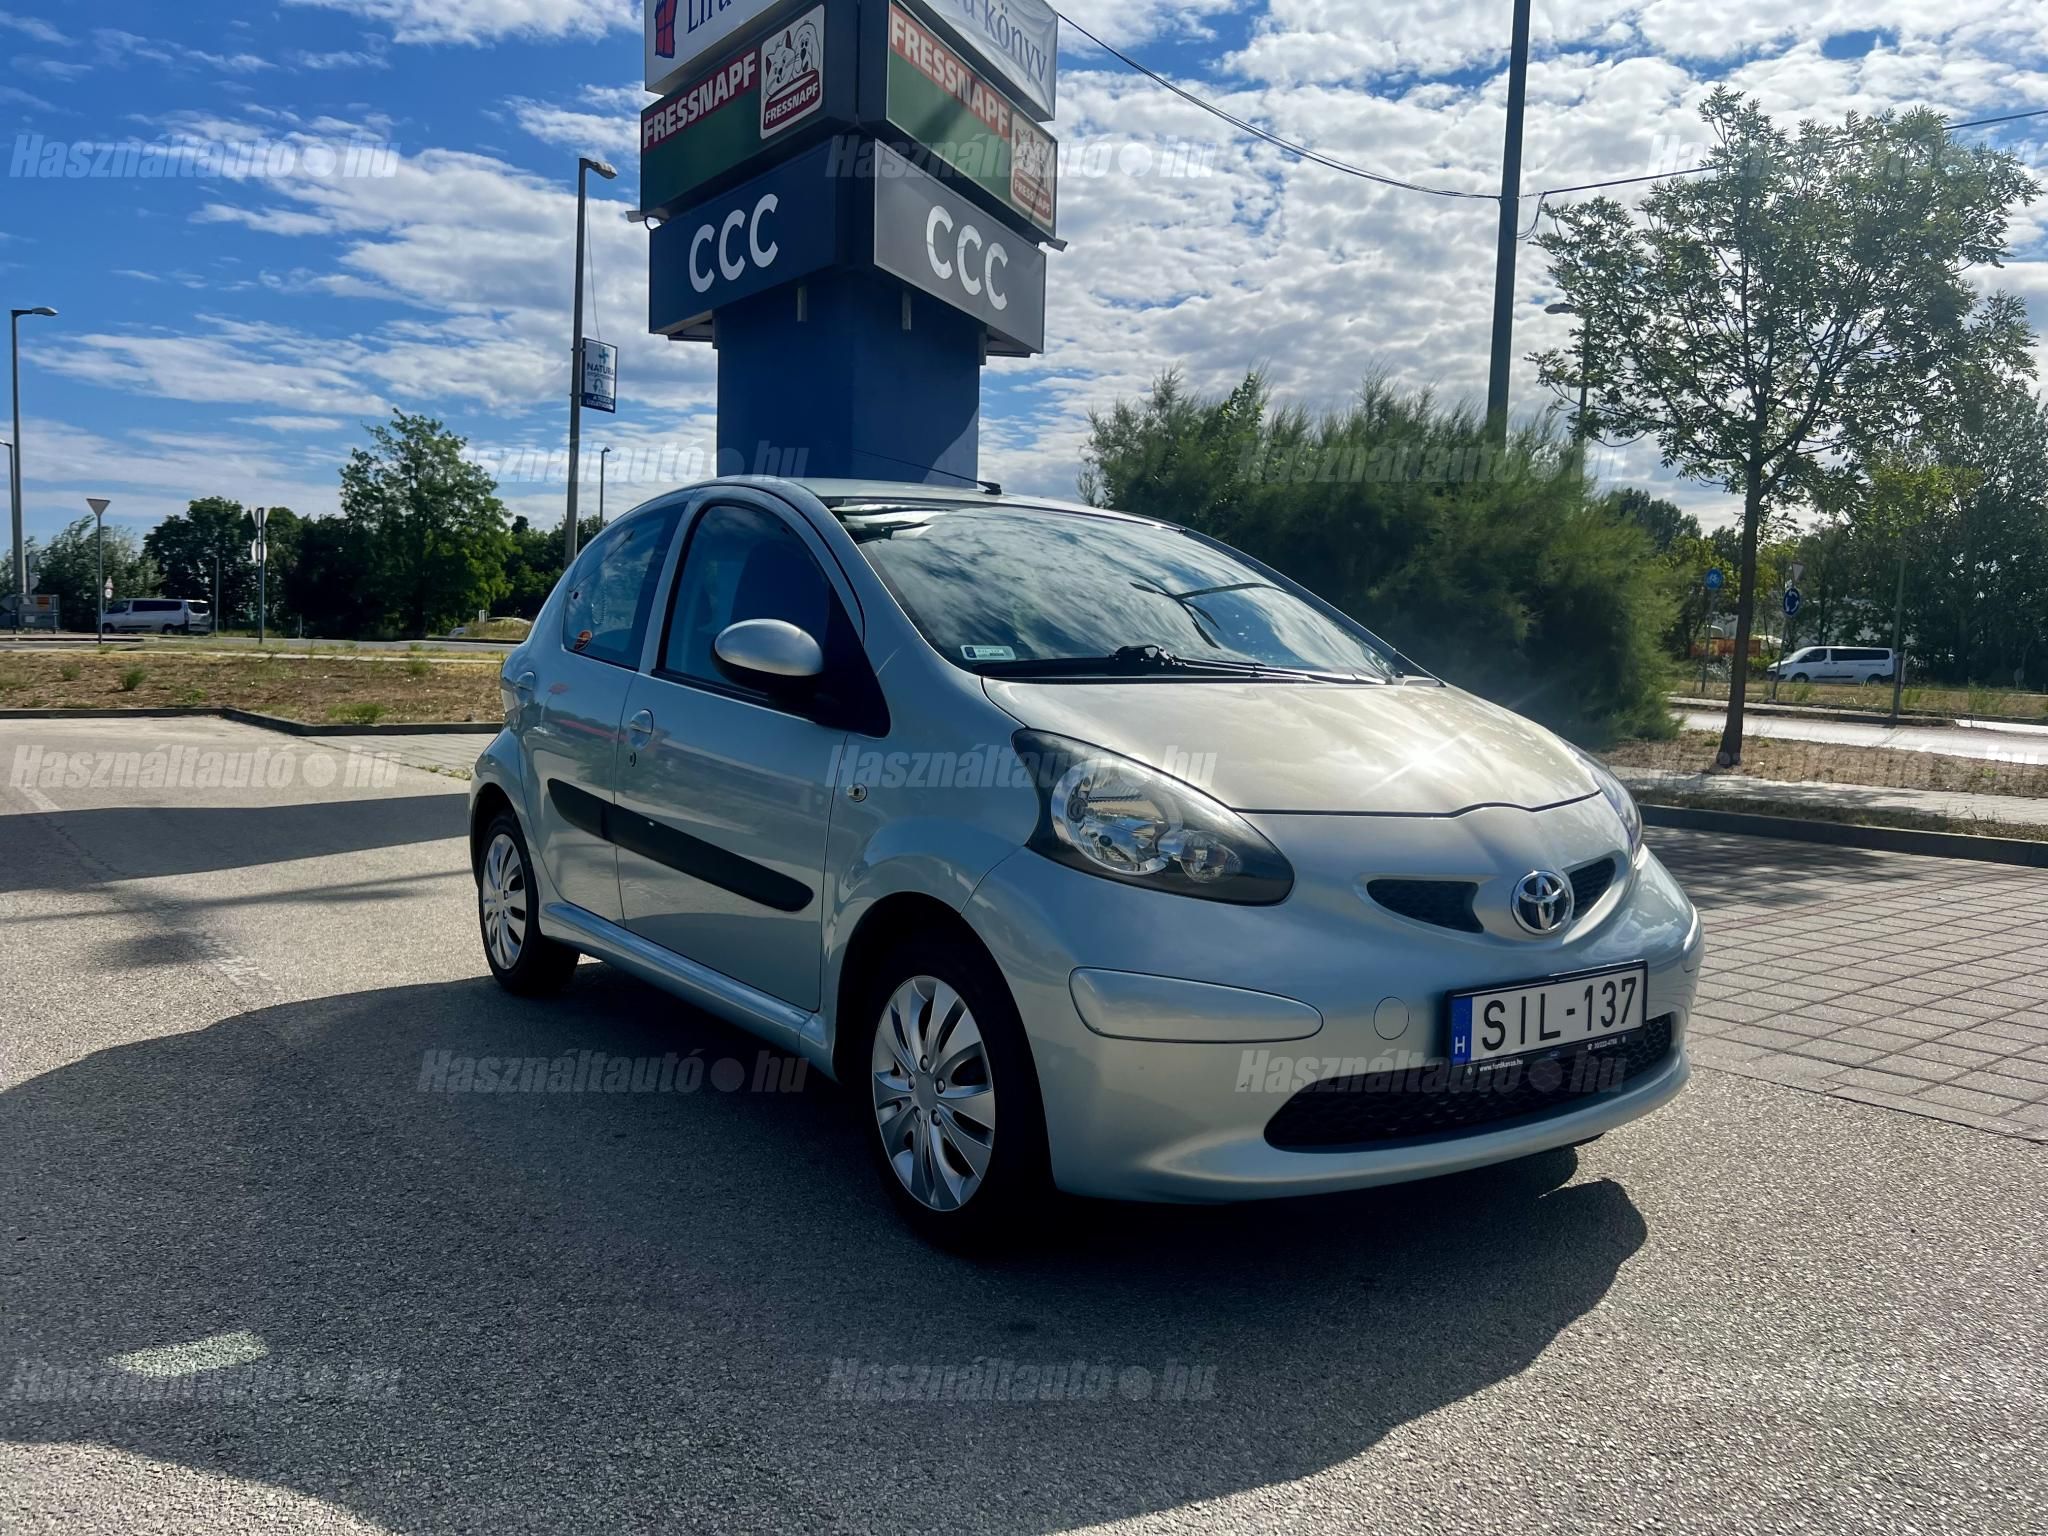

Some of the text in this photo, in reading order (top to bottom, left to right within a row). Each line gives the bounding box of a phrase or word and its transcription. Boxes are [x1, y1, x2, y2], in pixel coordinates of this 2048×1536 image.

[642, 51, 756, 148] FRESSNAPF
[766, 83, 819, 124] FRESSNAPF
[891, 12, 1010, 133] FRESSNAPF
[689, 194, 779, 293] CCC
[926, 205, 1009, 311] CCC
[1455, 977, 1637, 1055] H SIL-137
